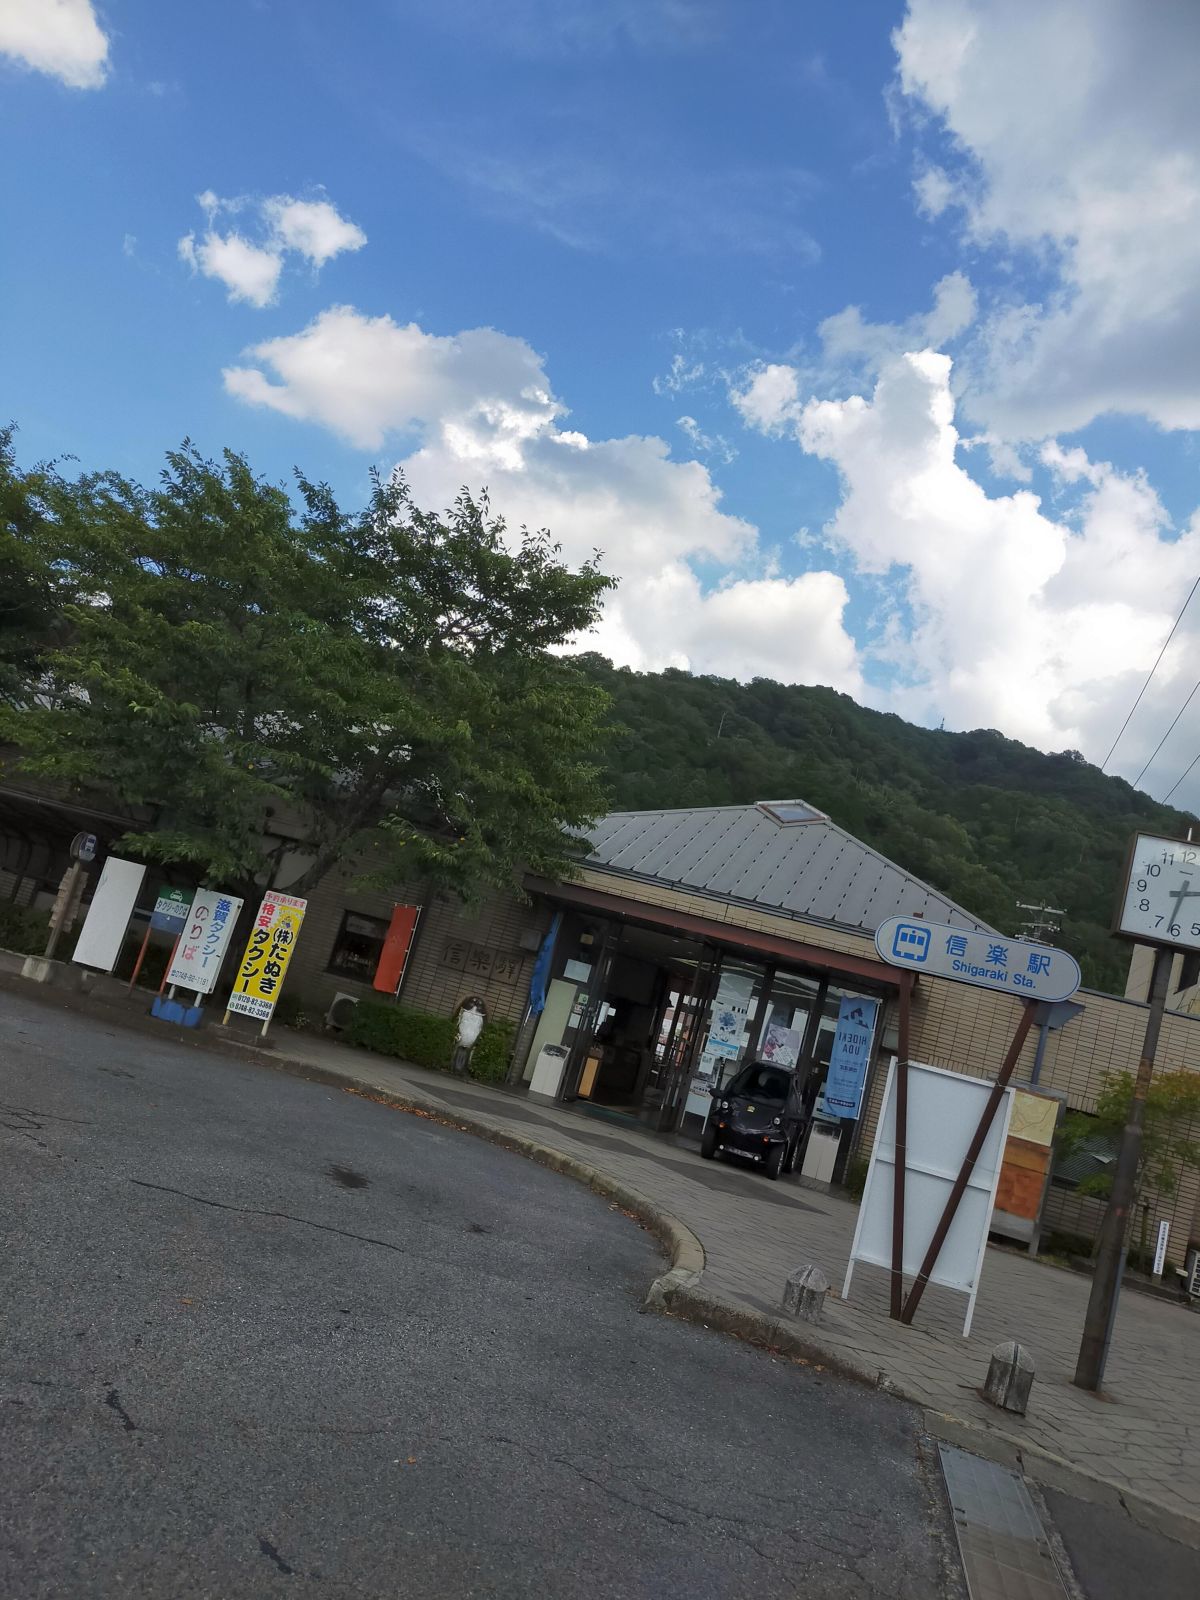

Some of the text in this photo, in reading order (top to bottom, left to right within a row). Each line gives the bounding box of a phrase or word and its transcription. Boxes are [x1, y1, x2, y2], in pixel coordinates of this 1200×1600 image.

[1161, 852, 1174, 866] 11
[1182, 850, 1197, 864] 12
[1145, 863, 1161, 878] 10
[1136, 879, 1147, 892] 9
[1139, 898, 1150, 912] 8
[1154, 915, 1165, 928] 7
[182, 905, 210, 961] のりば
[201, 898, 233, 968] 滋賀タクシー
[1170, 923, 1181, 937] 6
[259, 927, 293, 995] (株)たぬき
[945, 934, 1052, 977] 信楽駅
[951, 959, 1037, 989] Shigaraki Sta.
